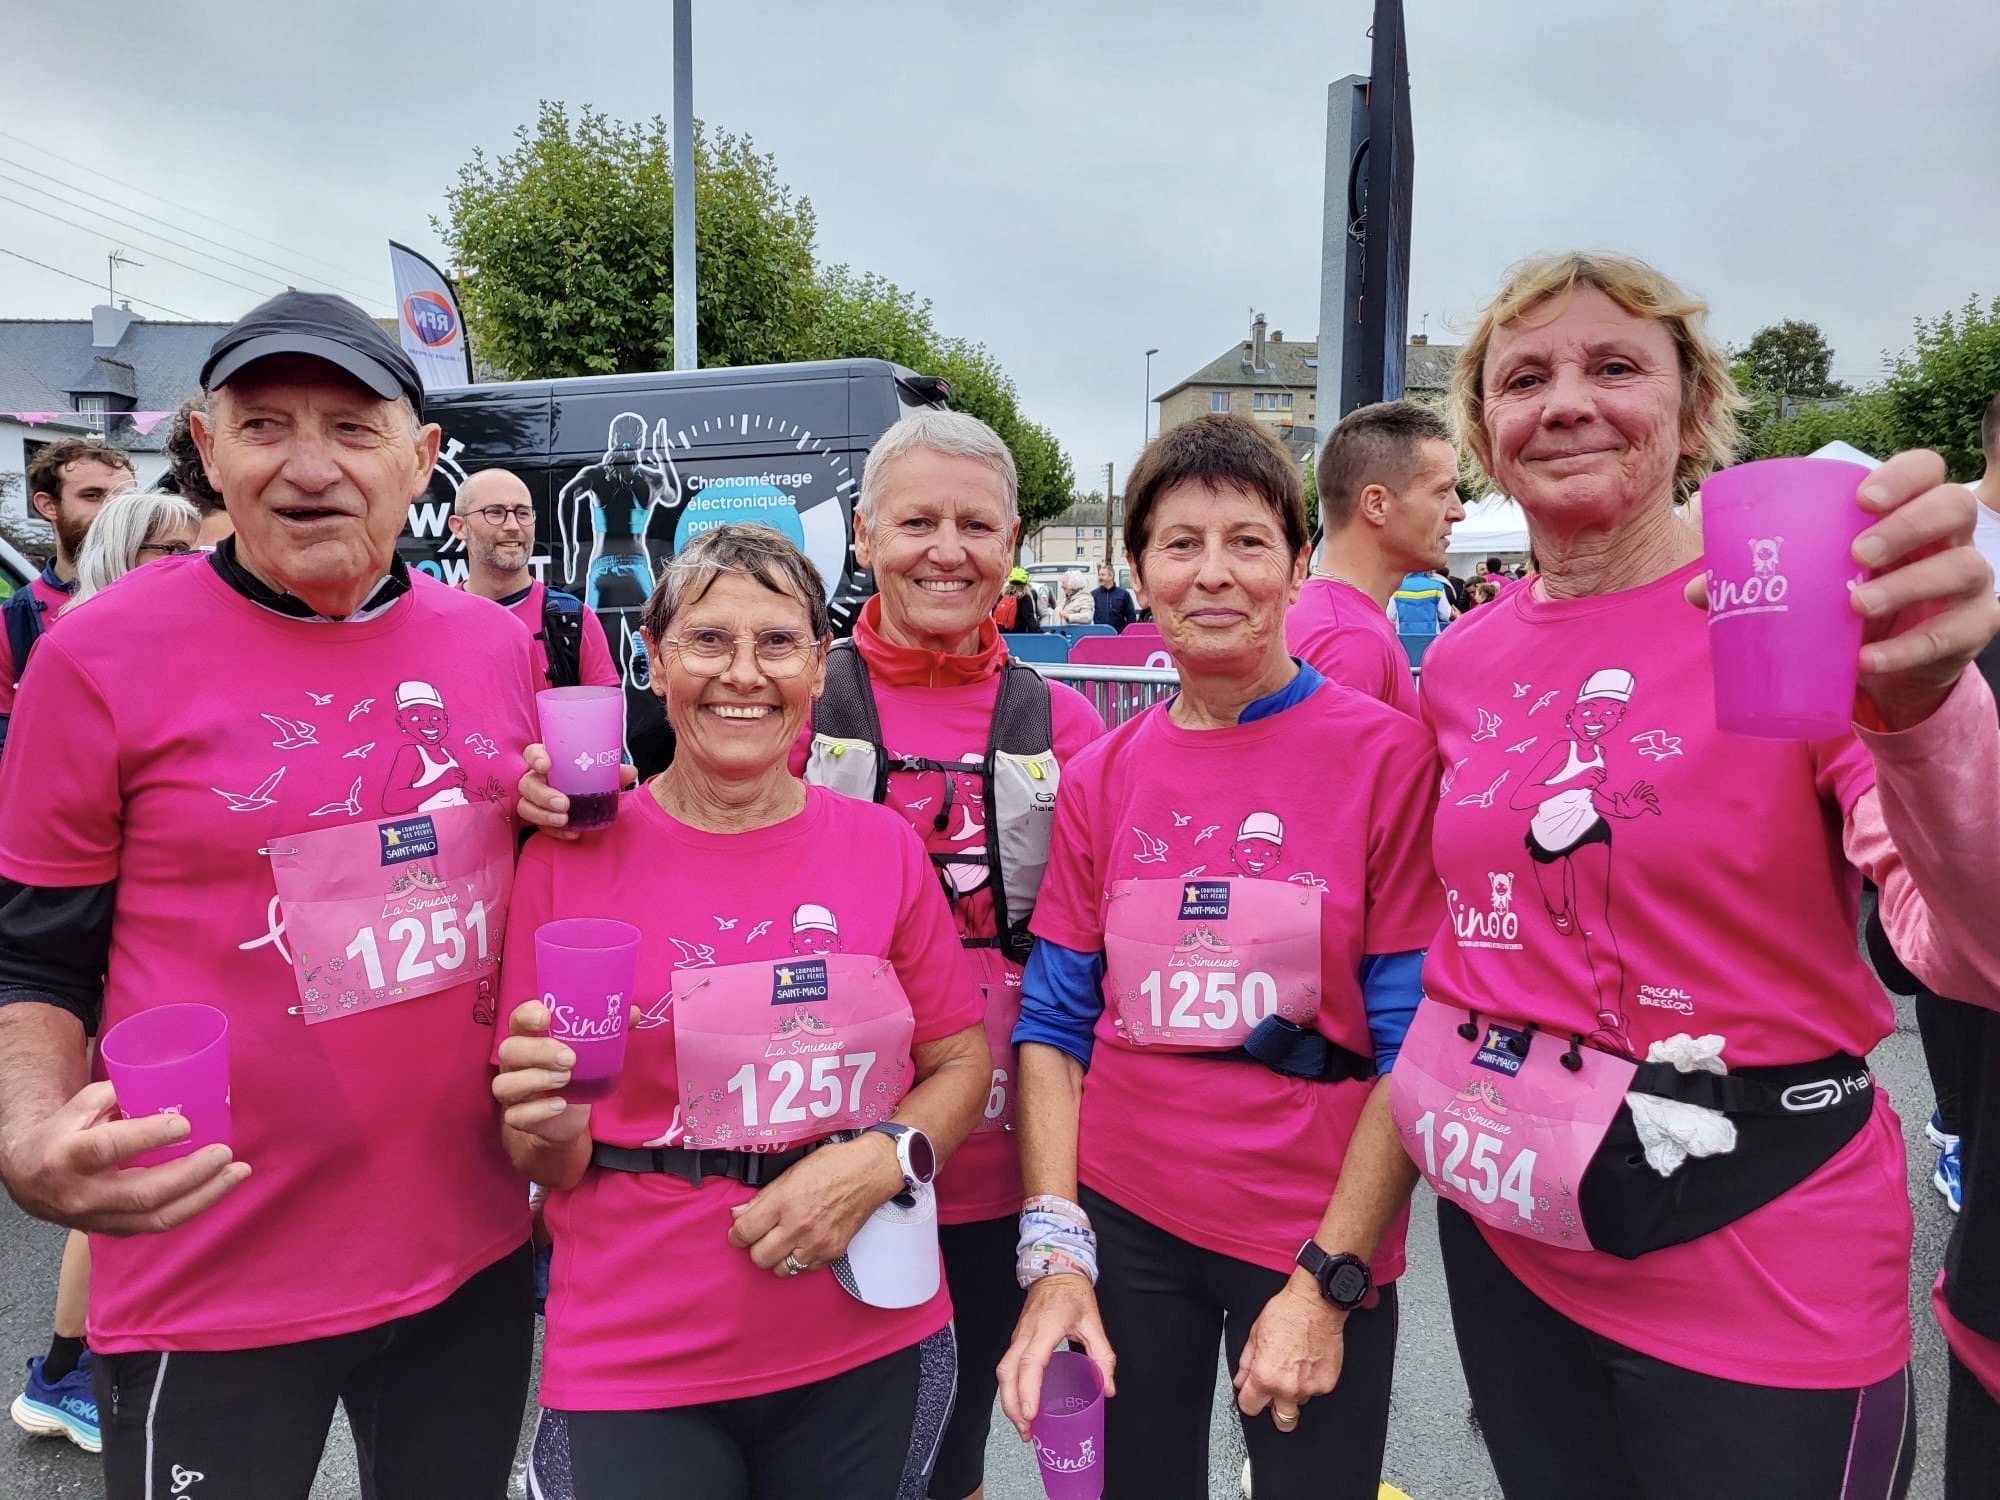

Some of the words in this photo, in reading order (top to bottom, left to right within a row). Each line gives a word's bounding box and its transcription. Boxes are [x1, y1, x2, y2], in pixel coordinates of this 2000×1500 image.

[687, 472, 813, 490] Chronométrage
[687, 494, 797, 511] électroniques
[385, 841, 436, 859] SAINT-MALO
[381, 903, 403, 919] La
[1182, 905, 1227, 915] SAINT-MALO
[345, 900, 488, 990] 1251
[1167, 953, 1186, 967] La
[1186, 953, 1241, 968] Sinueuse
[776, 985, 826, 999] SAINT-MALO
[1140, 970, 1278, 1030] 1250
[1640, 984, 1692, 999] PASCAL
[552, 1005, 622, 1037] Sinoo
[764, 1042, 786, 1058] La
[788, 1040, 845, 1056] Sinueuse
[1477, 1050, 1520, 1071] SAINT-MALO
[727, 1051, 877, 1127] 1257
[1444, 1100, 1462, 1117] La
[1462, 1107, 1512, 1135] Sinueuse
[1415, 1110, 1538, 1220] 1254
[58, 1395, 99, 1423] HOKA
[1042, 1447, 1096, 1470] Sinoo
